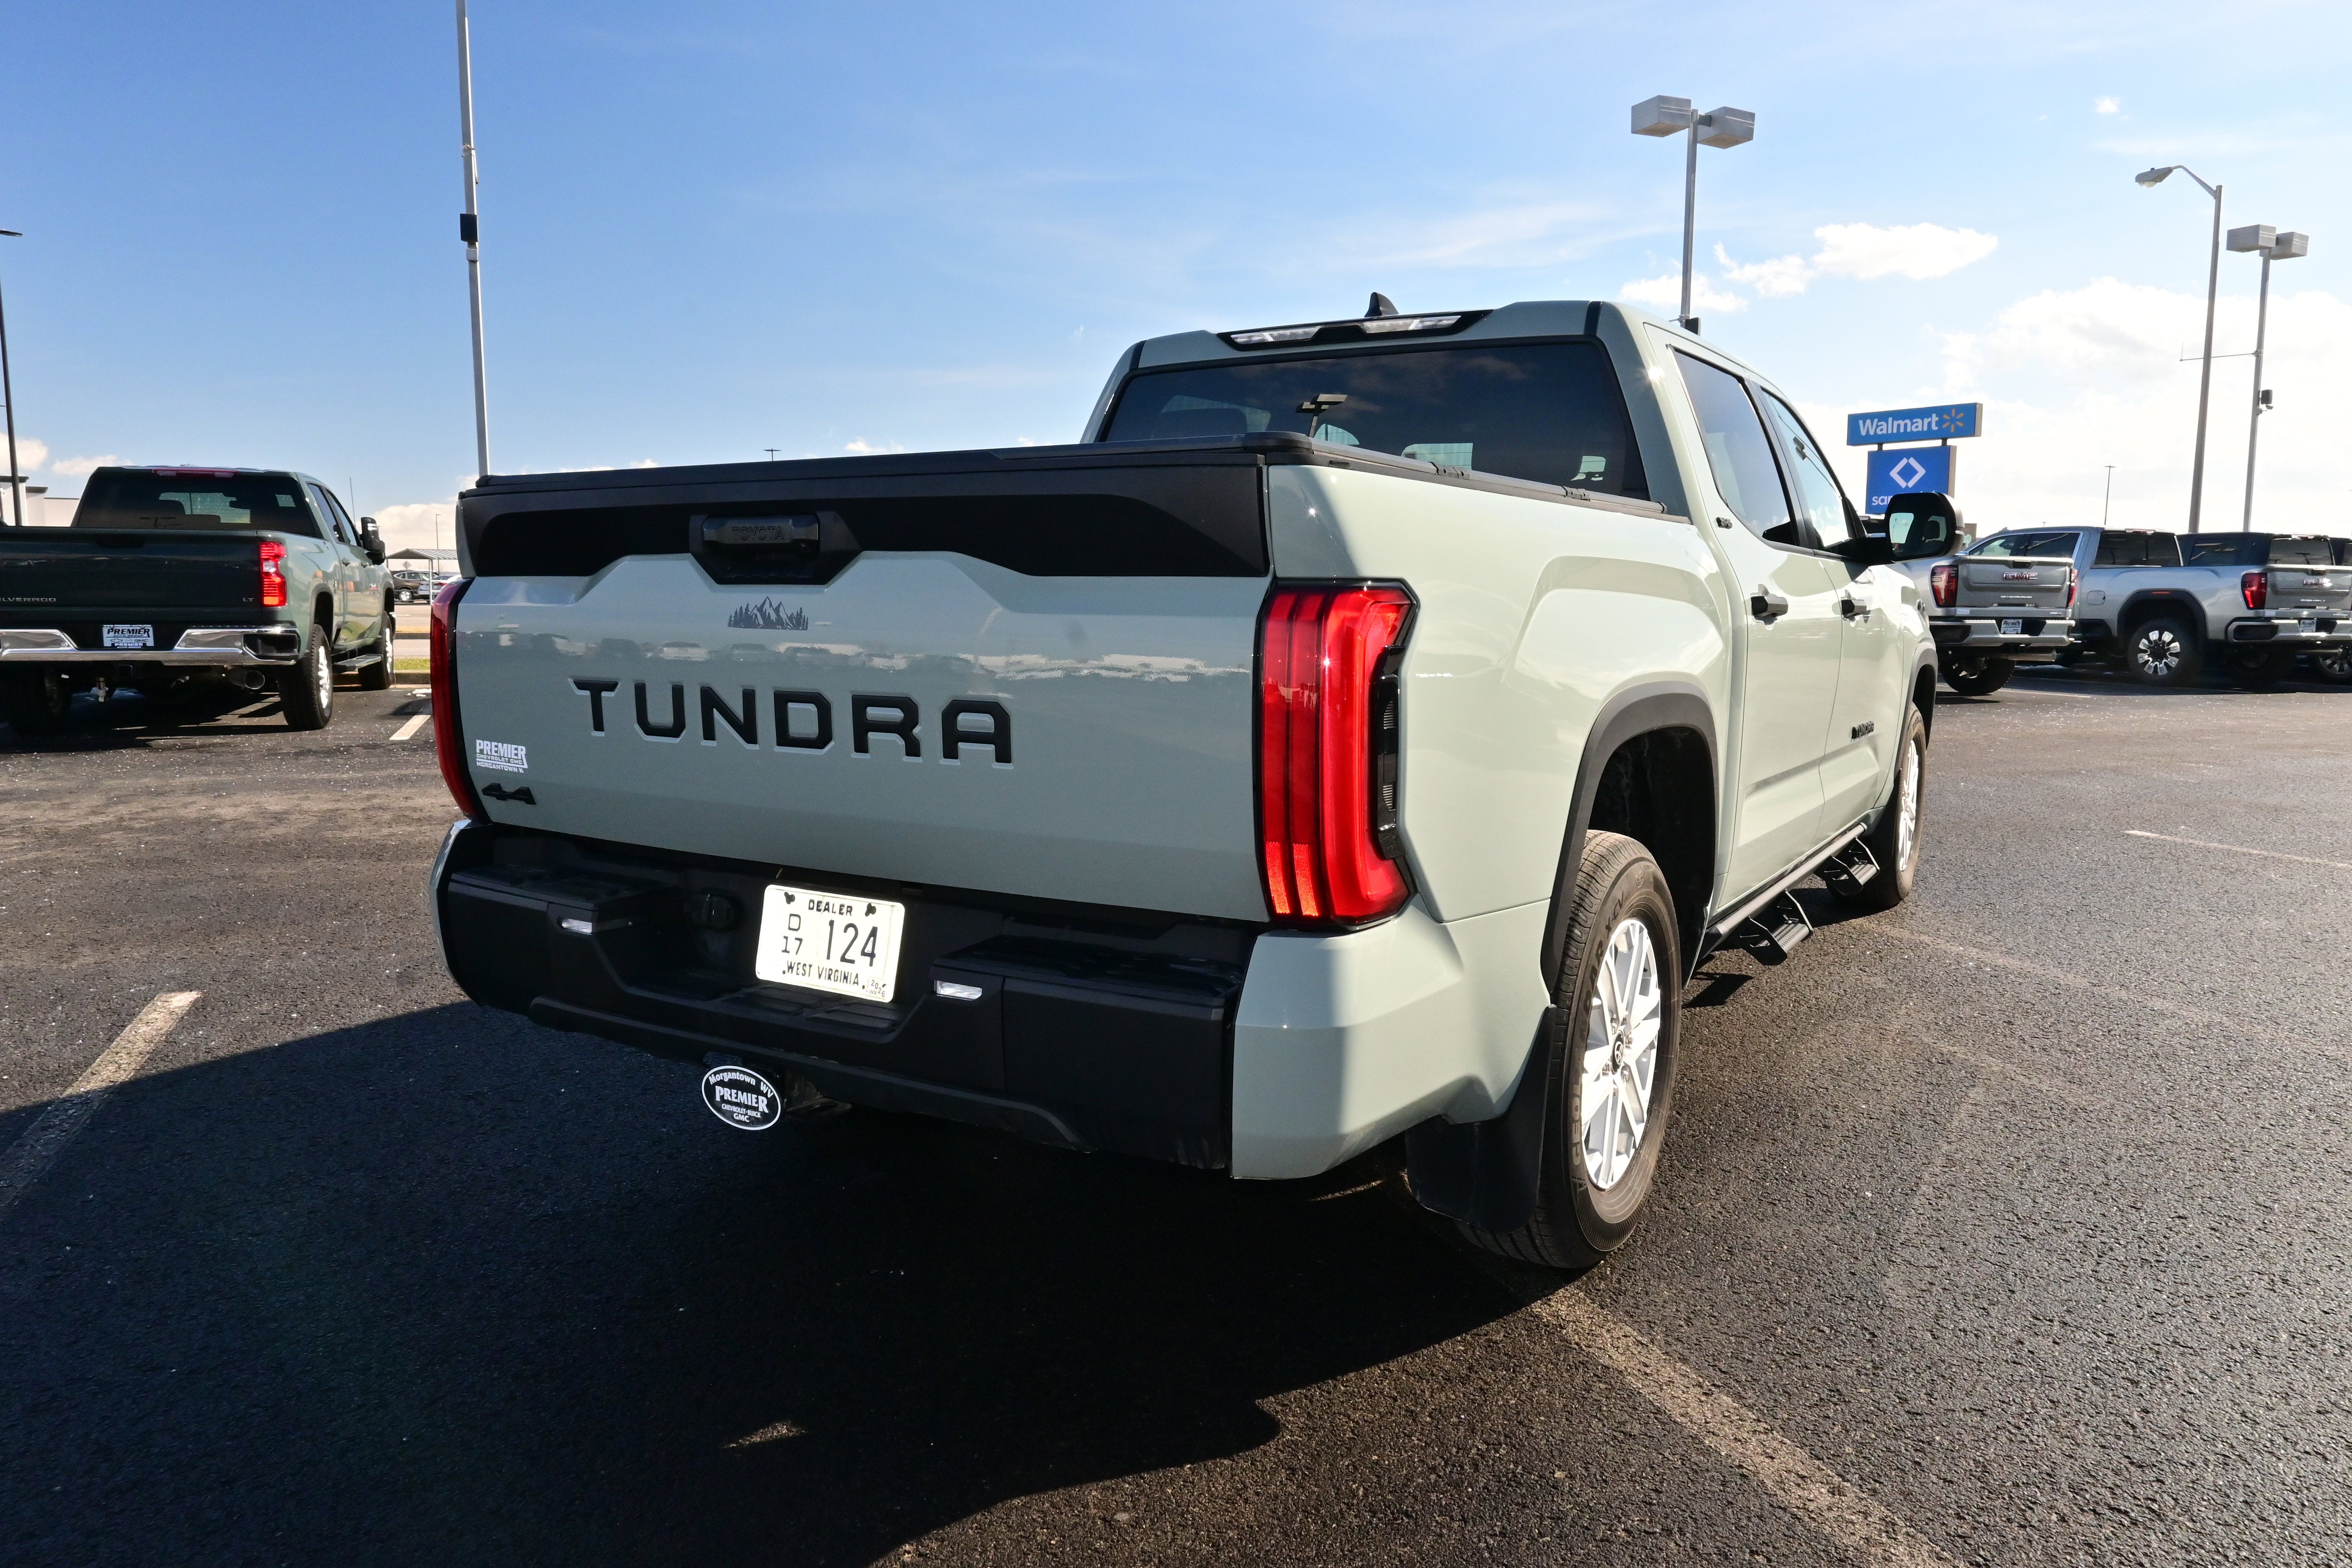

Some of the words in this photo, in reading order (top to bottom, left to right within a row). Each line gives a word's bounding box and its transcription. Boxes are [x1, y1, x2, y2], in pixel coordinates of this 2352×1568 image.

[1859, 414, 1939, 436] Walmart
[731, 525, 784, 541] TOYOTA
[2003, 572, 2038, 581] GMC
[572, 678, 1013, 765] TUNDRA
[476, 739, 526, 760] PREMIER
[476, 753, 509, 762] CHEVROLET
[476, 760, 518, 773] MORGANTOWN
[808, 899, 853, 916] DEALER
[788, 914, 801, 931] D
[781, 936, 803, 955] 17
[826, 919, 878, 967] 124
[787, 960, 813, 977] WEST
[818, 966, 859, 986] VIRGINIA
[871, 980, 885, 997] 2026
[708, 1071, 756, 1086] Morgantown
[760, 1081, 774, 1098] WV
[715, 1085, 769, 1113] PREMIER
[733, 1113, 750, 1122] GMC
